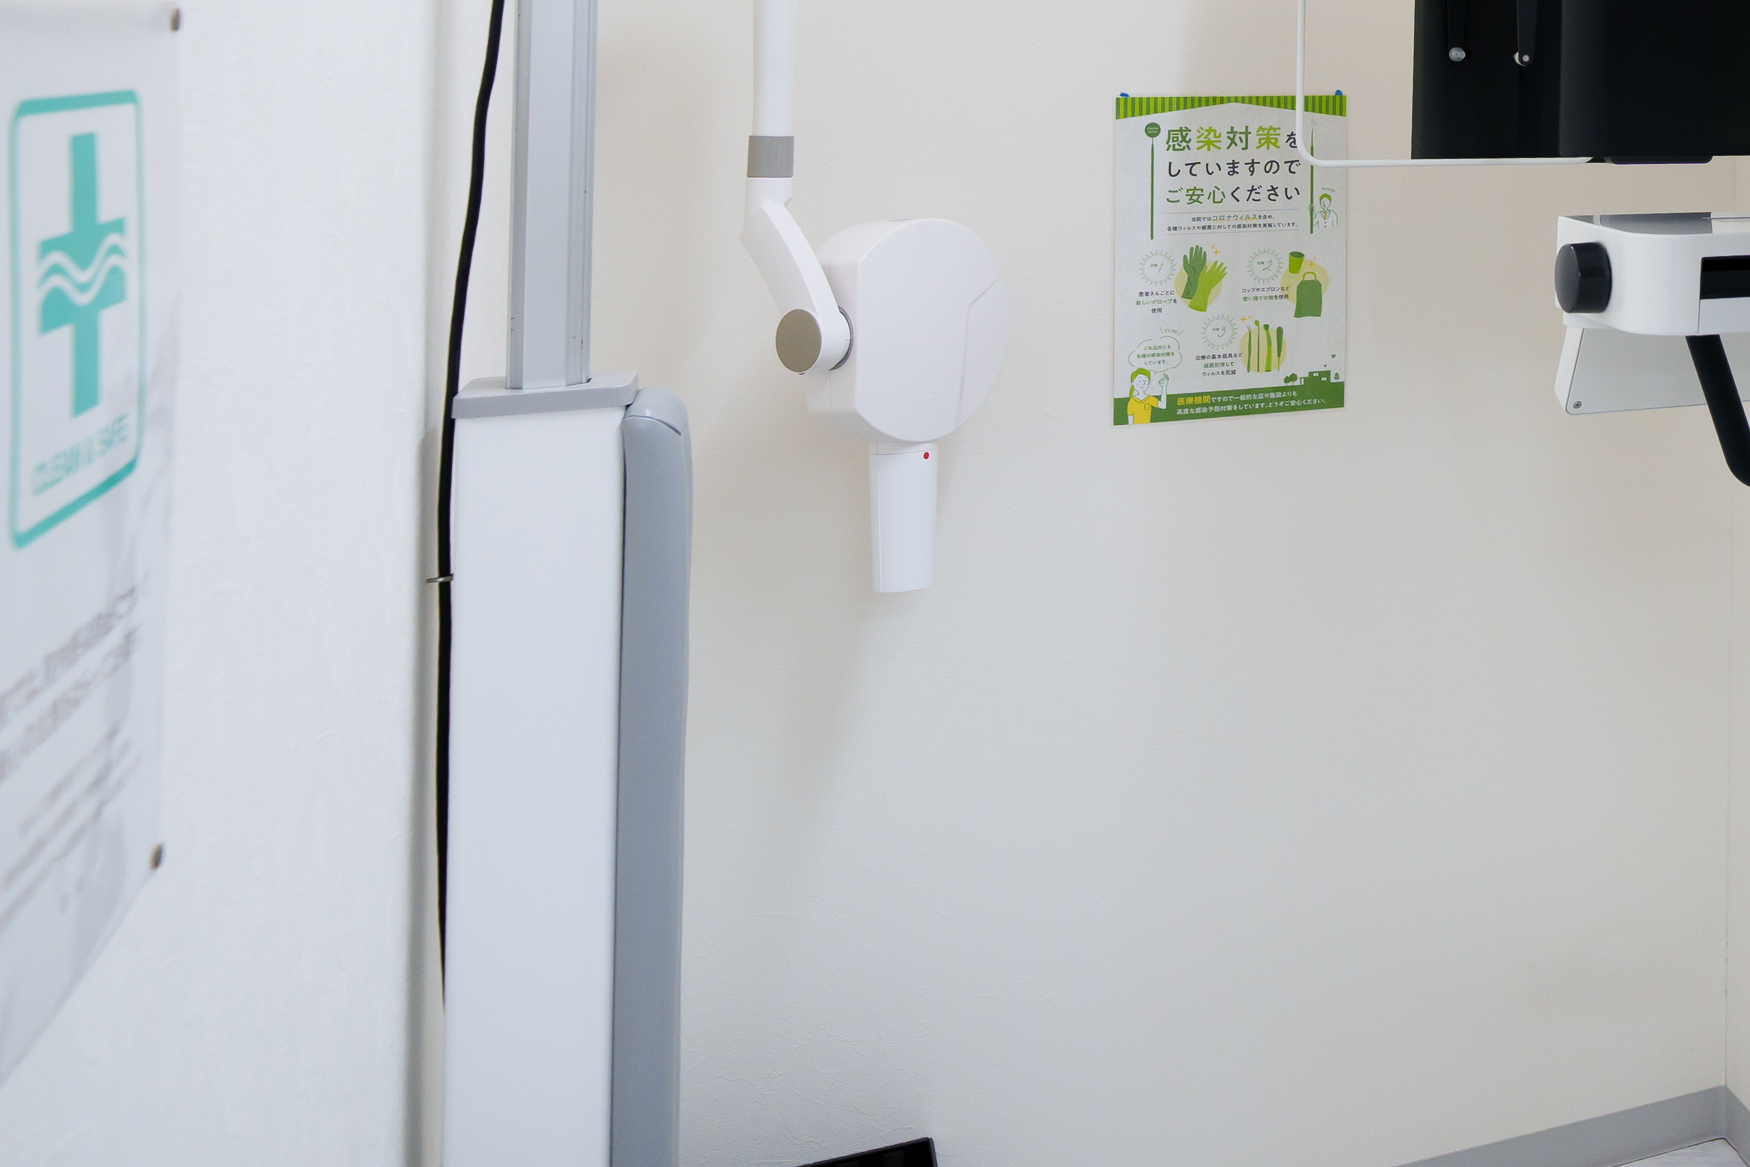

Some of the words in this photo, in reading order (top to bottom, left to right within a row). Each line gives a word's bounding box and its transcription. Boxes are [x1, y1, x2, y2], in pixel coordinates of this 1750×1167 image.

[1165, 125, 1297, 152] 感染対策を
[1168, 159, 1301, 178] していますので
[1166, 184, 1300, 205] ご安心ください
